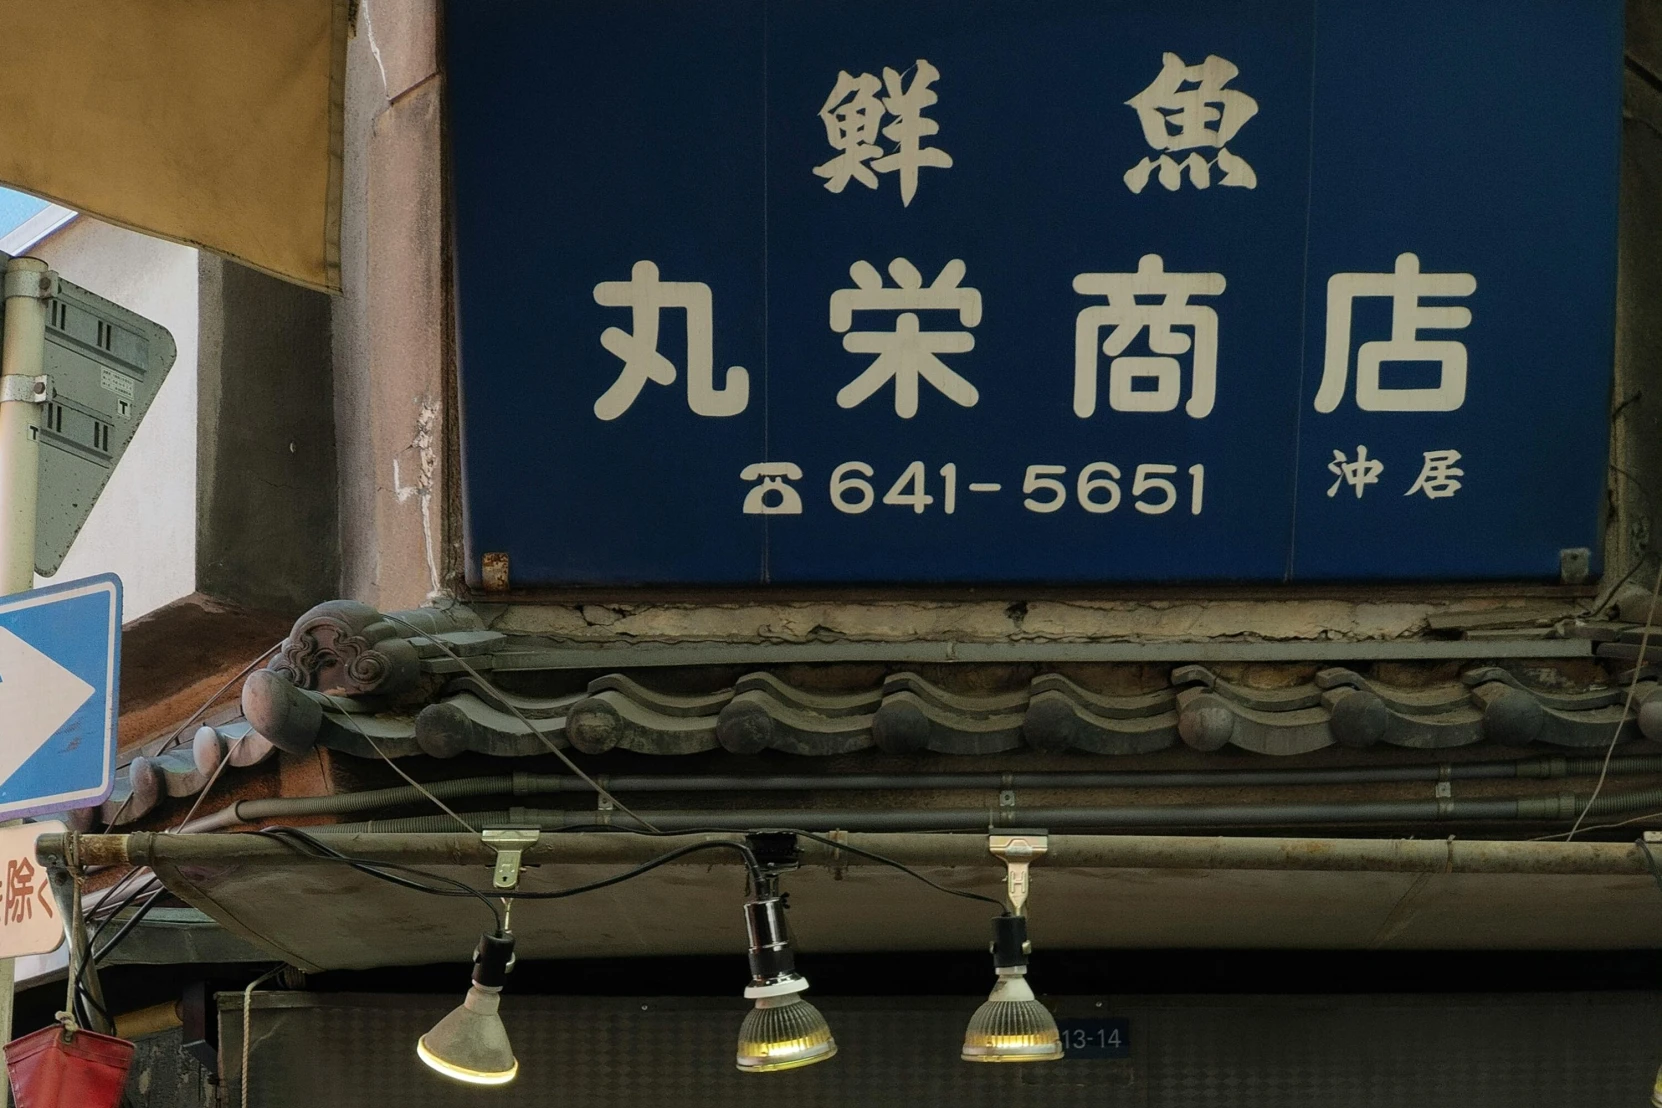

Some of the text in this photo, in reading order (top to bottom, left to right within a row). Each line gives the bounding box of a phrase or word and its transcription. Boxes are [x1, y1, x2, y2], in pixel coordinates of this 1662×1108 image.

[813, 53, 1259, 208] 鮮魚
[592, 252, 1478, 422] 丸栄商店
[828, 460, 1204, 516] 641-5651
[1326, 446, 1467, 500] 沖居
[0, 856, 53, 926] 除く
